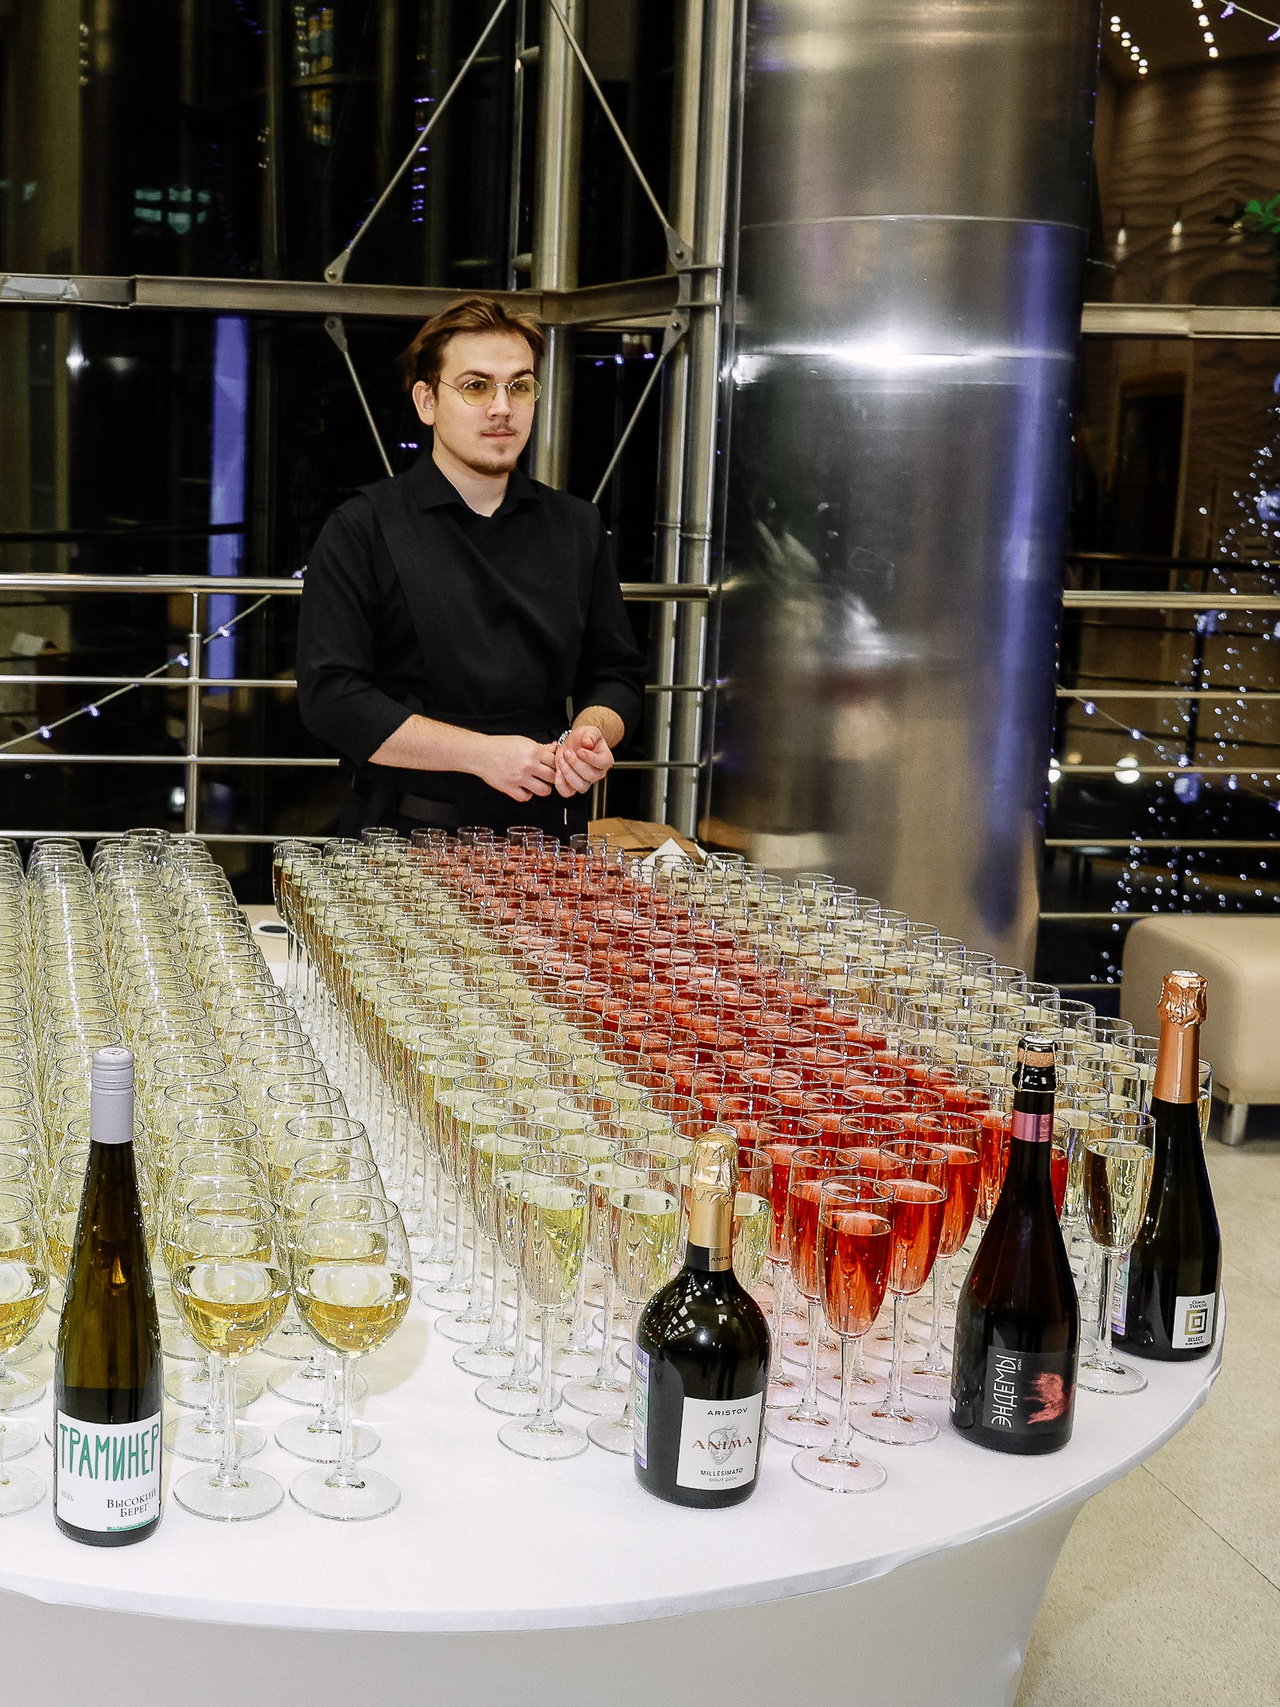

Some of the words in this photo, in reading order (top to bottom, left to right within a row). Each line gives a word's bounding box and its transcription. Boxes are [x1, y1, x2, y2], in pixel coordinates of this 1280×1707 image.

[991, 1354, 1018, 1429] ЭНДЕМЫ
[707, 1407, 749, 1416] ARISTOV
[691, 1436, 753, 1450] ANIMA
[59, 1423, 160, 1482] ТРАМИНЕР
[700, 1467, 744, 1477] MILLESIMATO
